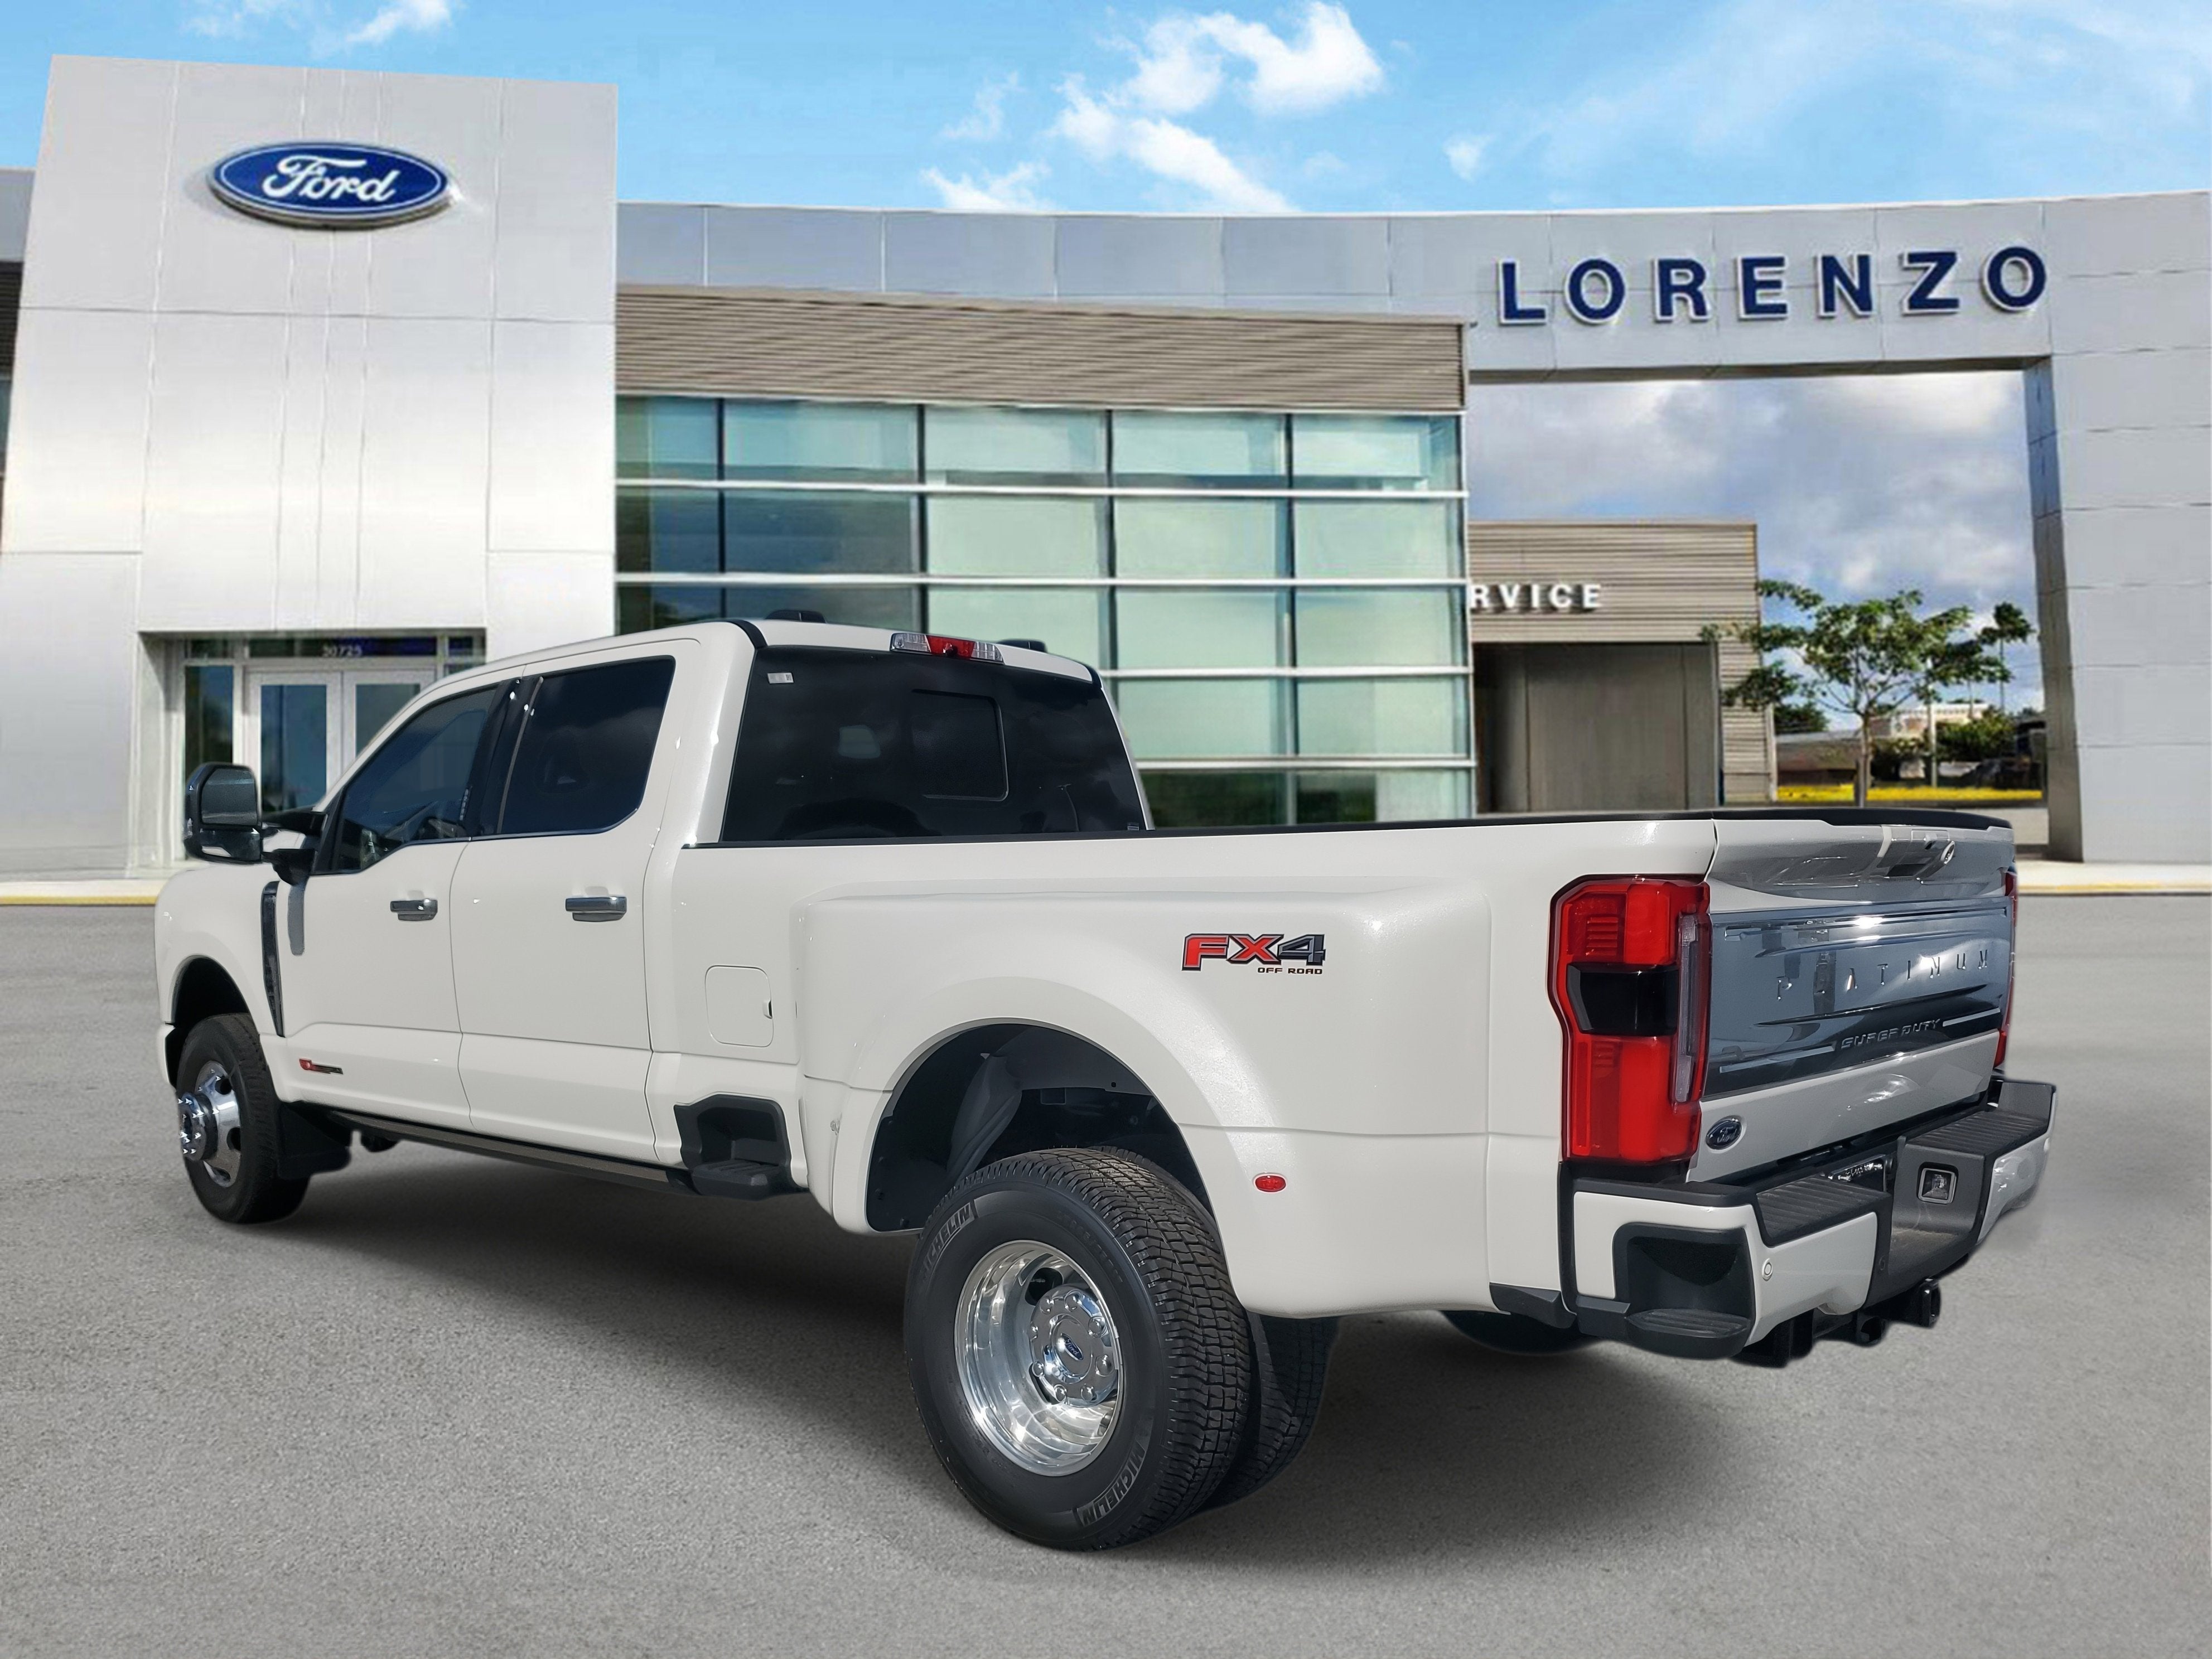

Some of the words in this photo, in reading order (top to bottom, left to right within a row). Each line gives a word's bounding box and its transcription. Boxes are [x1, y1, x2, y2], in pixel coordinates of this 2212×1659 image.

[263, 154, 400, 201] Ford
[1498, 245, 2047, 325] LORENZO
[1182, 934, 1326, 971] FX4
[1841, 1028, 1900, 1049] SUPER
[1901, 1018, 1941, 1037] DUTY
[921, 1202, 974, 1279] ICHELIN
